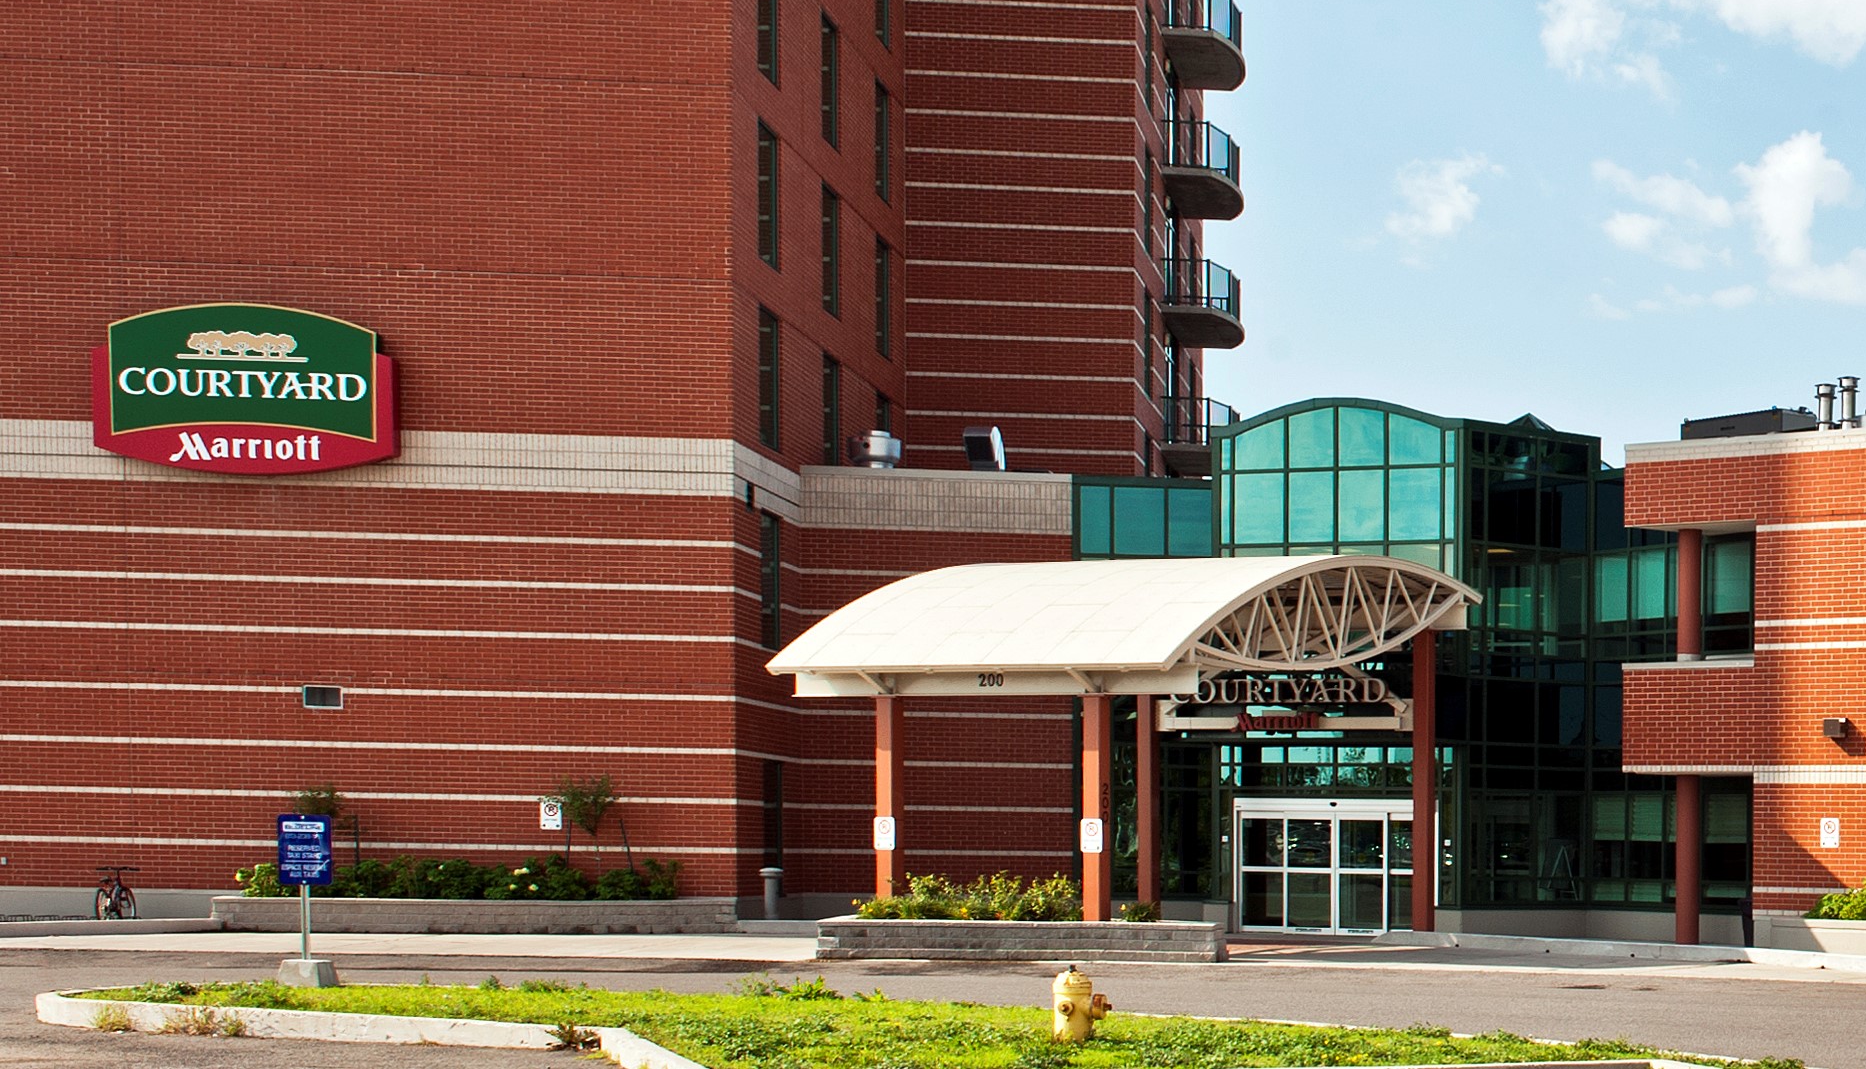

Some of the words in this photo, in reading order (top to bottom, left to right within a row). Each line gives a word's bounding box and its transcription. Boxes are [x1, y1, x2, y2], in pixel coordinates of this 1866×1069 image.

[118, 366, 368, 402] COURTYARD
[169, 432, 321, 463] Marriott
[978, 673, 1004, 687] 200
[1231, 712, 1320, 732] Marriott
[287, 844, 321, 852] RESERVED
